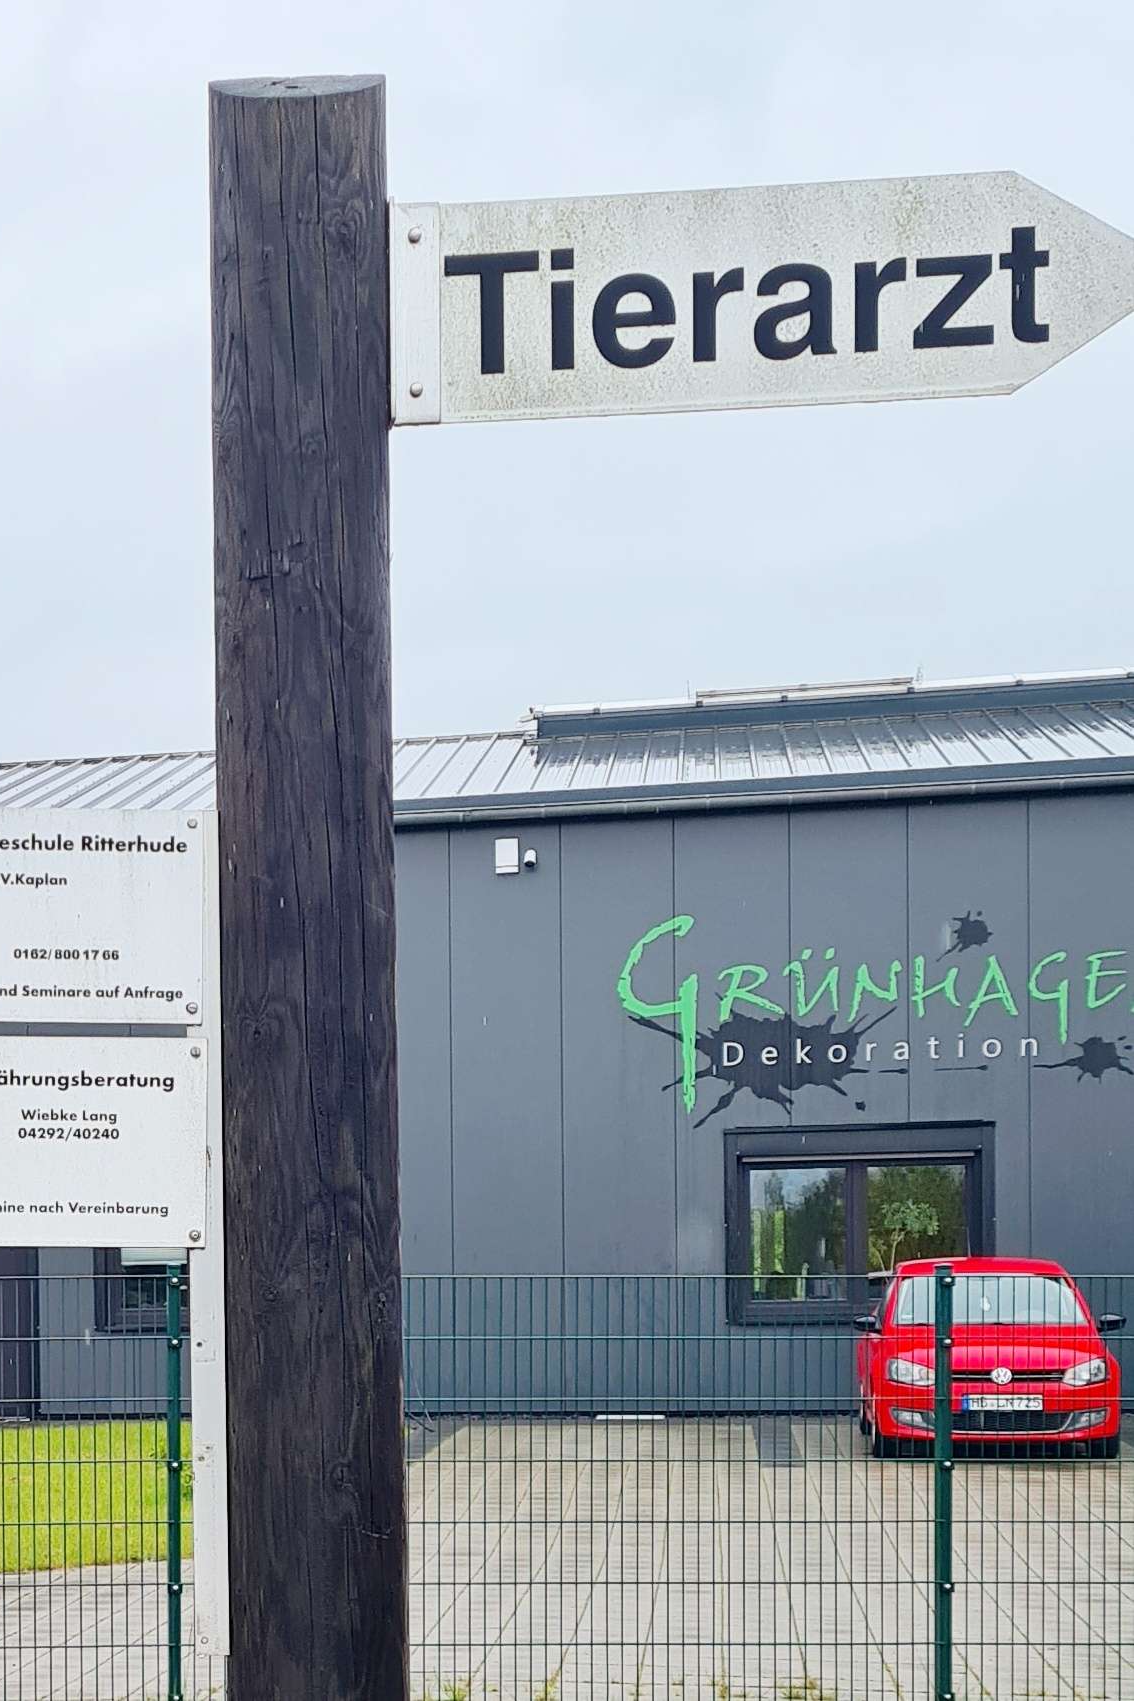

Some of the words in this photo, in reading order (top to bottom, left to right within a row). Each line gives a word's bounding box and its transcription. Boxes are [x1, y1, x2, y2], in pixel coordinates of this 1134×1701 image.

[444, 226, 1050, 375] Tierarzt
[81, 835, 188, 853] Ritterhude
[22, 985, 91, 998] Seminare
[95, 985, 120, 998] auf
[123, 986, 183, 1002] Anfrage
[617, 914, 1134, 1116] GRÜNHAGE
[721, 1033, 1039, 1067] Dekoration
[21, 1108, 78, 1122] Wiebke
[82, 1110, 117, 1125] Lang
[17, 1127, 120, 1142] 04292/40240
[29, 1201, 64, 1213] nach
[68, 1201, 169, 1217] Vereinbarung
